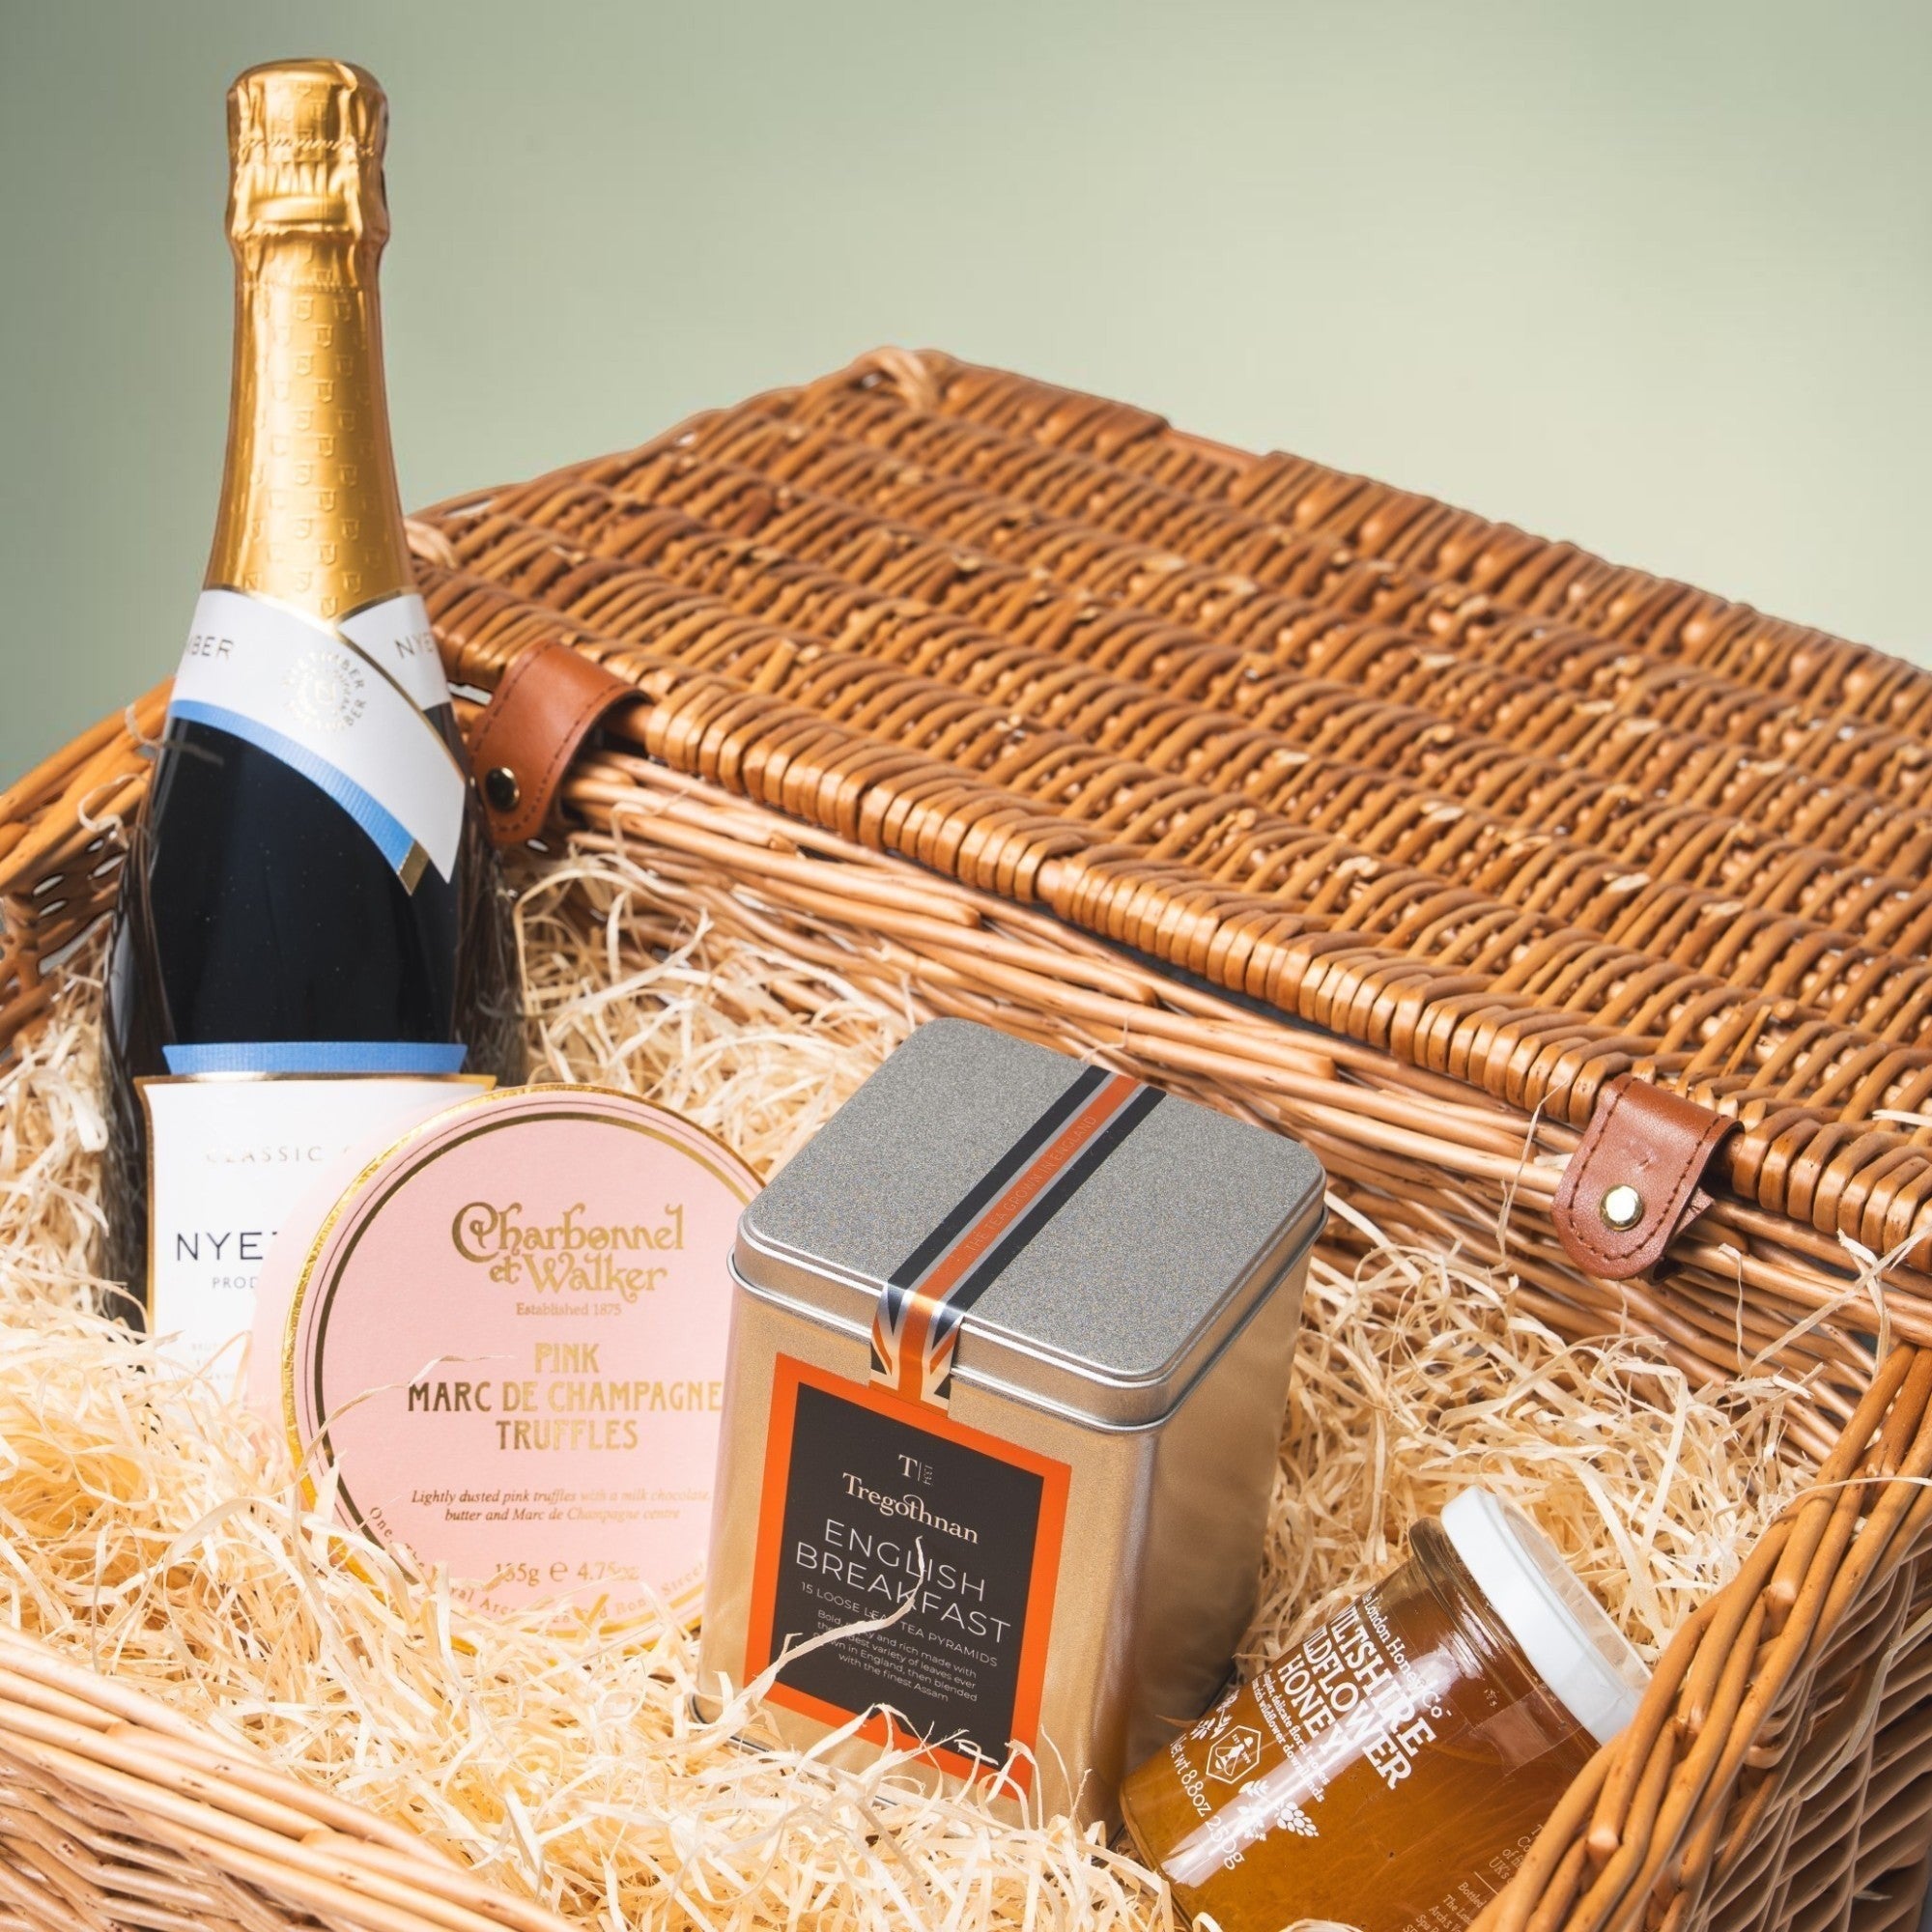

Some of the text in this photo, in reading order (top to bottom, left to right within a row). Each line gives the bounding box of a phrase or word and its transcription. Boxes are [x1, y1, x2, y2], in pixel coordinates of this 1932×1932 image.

[177, 1232, 277, 1261] NYE
[452, 1202, 684, 1263] Charbonnel
[525, 1253, 668, 1302] Walker
[516, 1302, 621, 1317] Established 1875
[534, 1343, 600, 1374] PINK
[408, 1380, 723, 1412] MARC DE CHAMPAGNE
[496, 1419, 638, 1450] TRUFFLES
[412, 1489, 456, 1506] Lightly
[459, 1489, 500, 1503] dusted
[502, 1489, 529, 1505] pink
[533, 1488, 577, 1505] truffles
[445, 1508, 482, 1521] butter
[485, 1508, 509, 1520] and
[512, 1509, 544, 1520] Marc
[549, 1508, 563, 1520] de
[567, 1506, 639, 1522] Champagne
[842, 1472, 978, 1544] Tregothnan
[825, 1519, 985, 1602] ENGLISH
[795, 1542, 1011, 1643] BREAKFAST
[801, 1581, 998, 1667] 15 LOOSE LEA TEA PYRAMIDS
[1364, 1597, 1391, 1642] London
[838, 1653, 949, 1702] with the finest Assam
[848, 1644, 978, 1702] in England, then blended
[872, 1644, 906, 1662] variety
[908, 1658, 920, 1666] of
[921, 1662, 952, 1680] leaves
[953, 1676, 976, 1690] ever
[877, 1634, 896, 1647] and
[899, 1642, 919, 1656] rich
[921, 1652, 952, 1668] made
[953, 1665, 977, 1679] with
[1271, 1693, 1293, 1728] delicate
[1289, 1724, 1313, 1754] floral
[1277, 1653, 1350, 1756] HONEY
[1259, 1699, 1287, 1745] wildflower
[1283, 1743, 1325, 1804] downlnds
[1181, 1769, 1212, 1817] 8.8oz
[1206, 1815, 1245, 1870] 250g
[1443, 1894, 1459, 1912] The
[1458, 1882, 1487, 1908] Bottled
